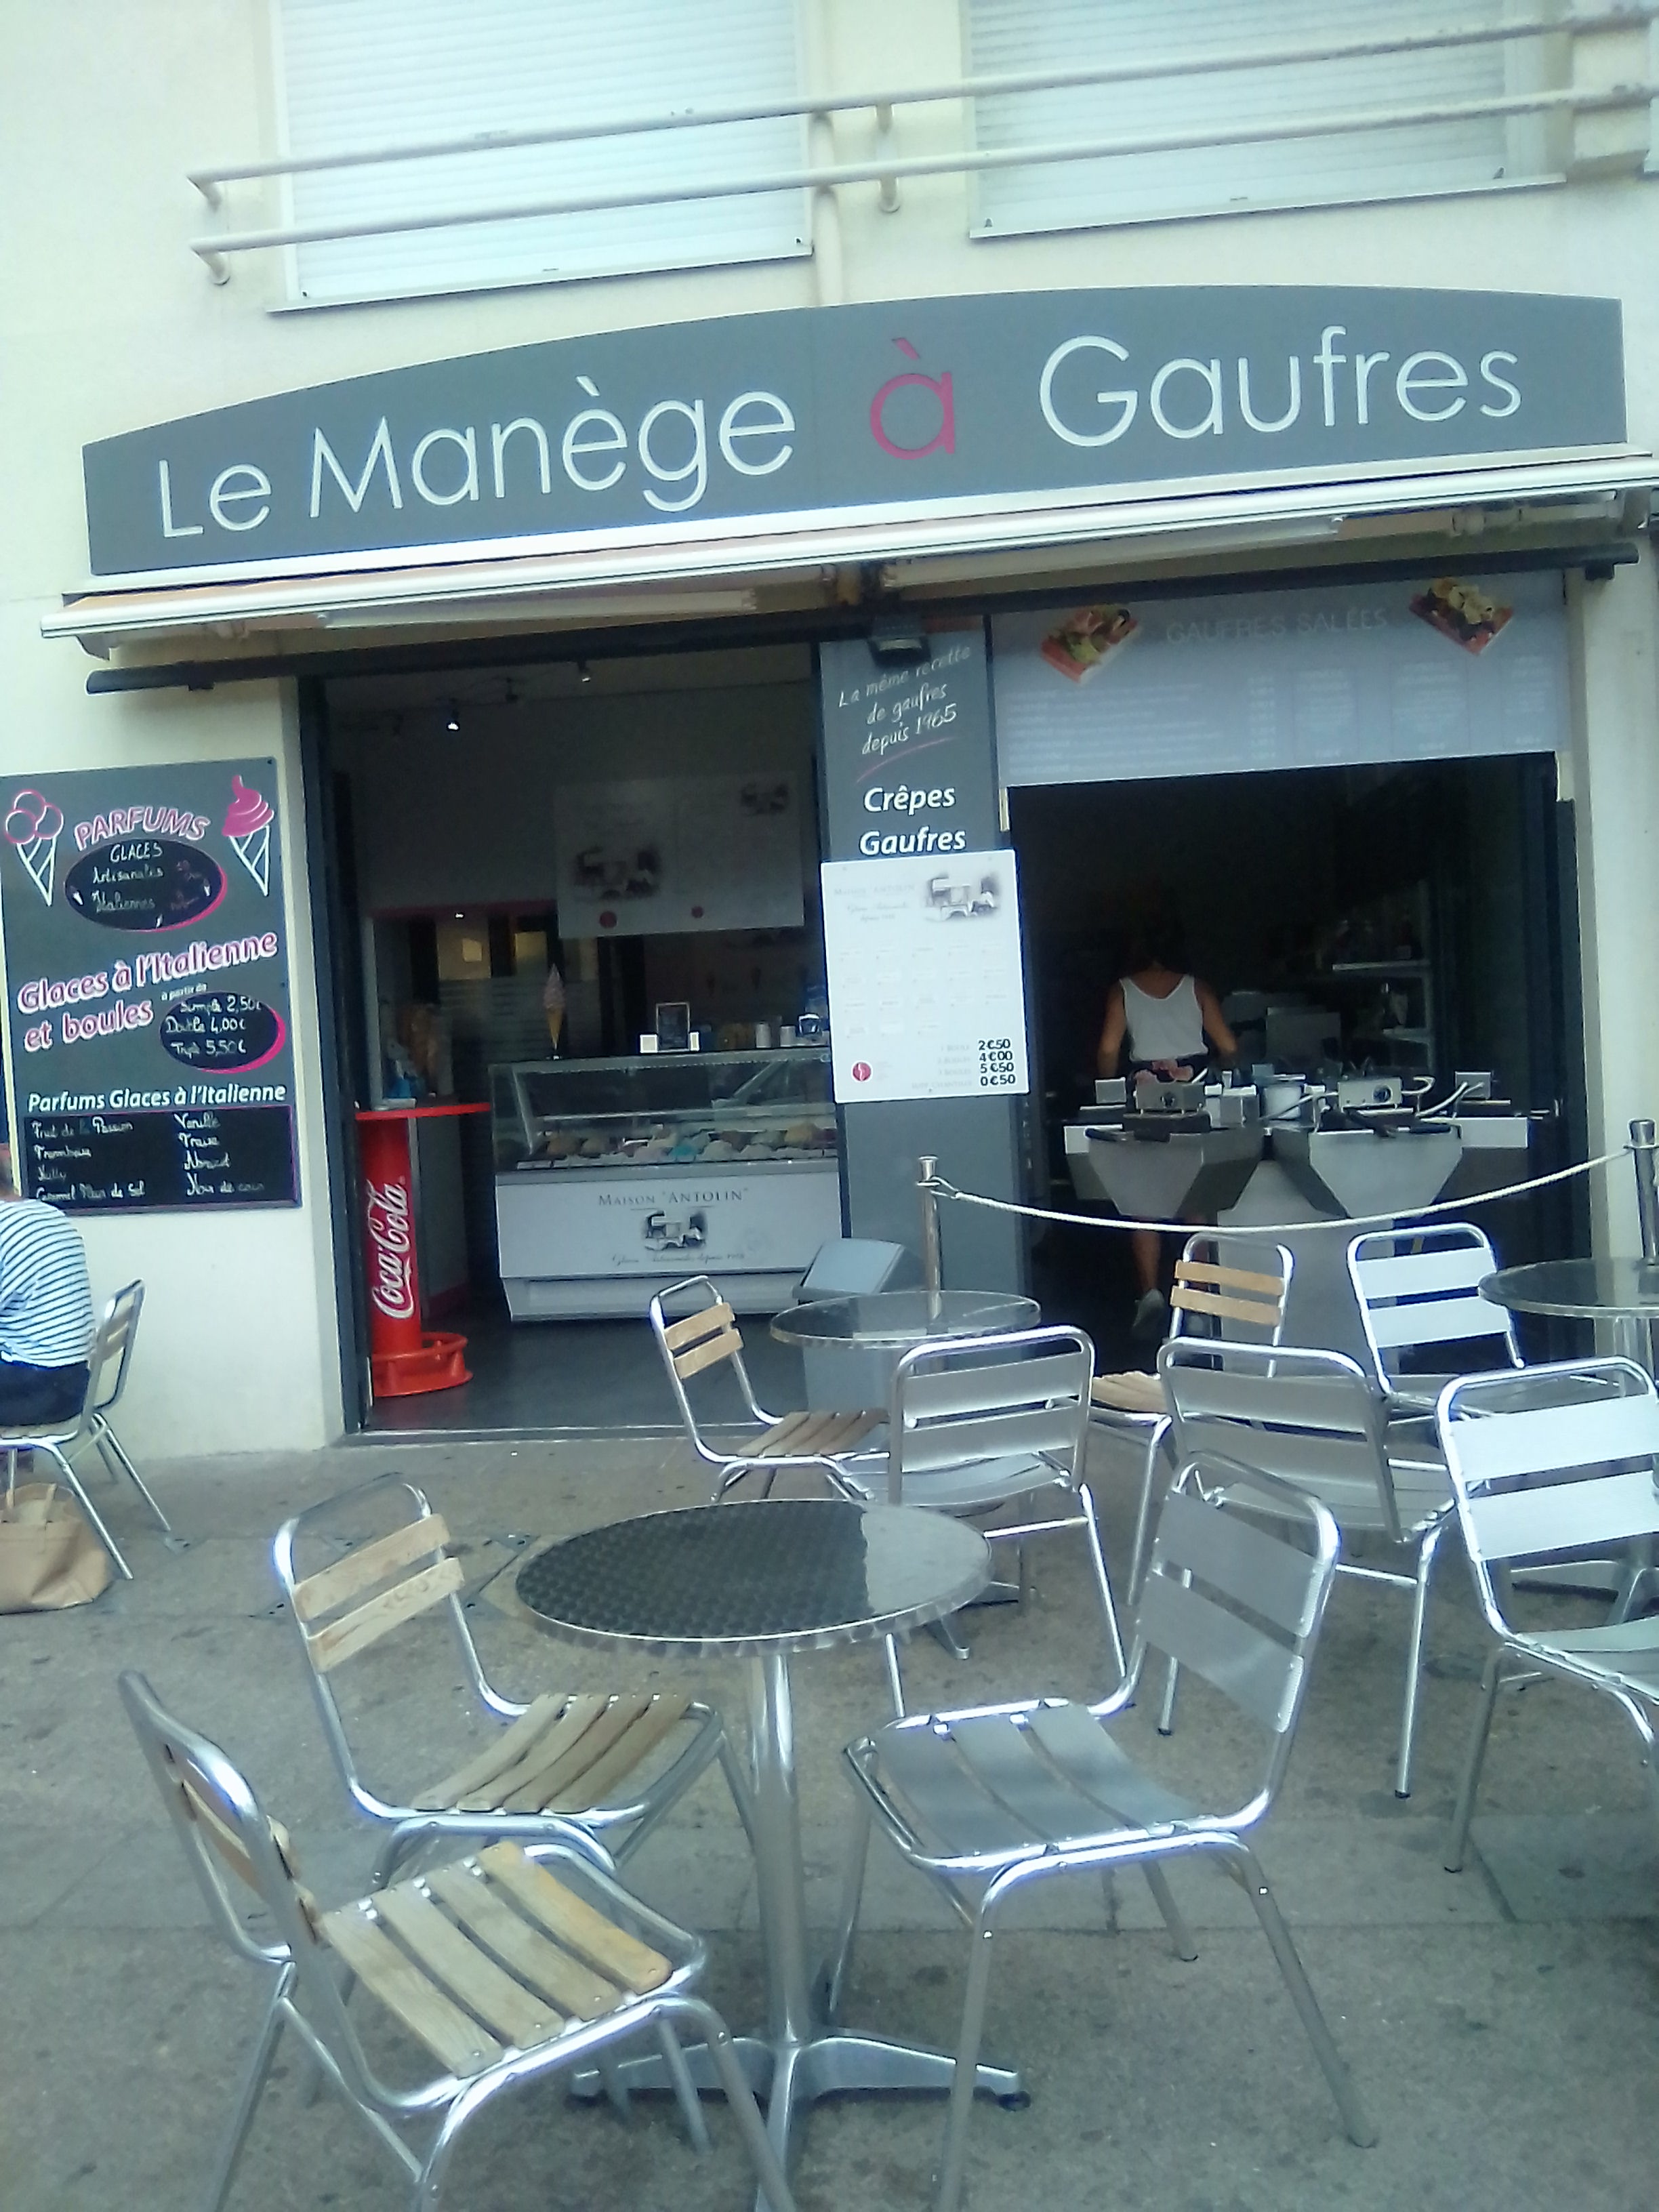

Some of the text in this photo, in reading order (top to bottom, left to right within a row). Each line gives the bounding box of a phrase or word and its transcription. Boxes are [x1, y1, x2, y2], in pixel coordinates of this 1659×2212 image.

[157, 325, 1522, 539] Le Manège à Gaufres
[839, 689, 860, 708] La
[916, 645, 970, 678] recette
[867, 682, 947, 725] de gaufres
[861, 703, 958, 755] depuis 1965
[864, 785, 956, 816] Crêpes
[74, 806, 211, 851] PARFUMS
[859, 826, 967, 856] Gaufres
[110, 842, 163, 863] GLACES
[18, 932, 279, 1015] Glaces à l'Italienne
[24, 1000, 154, 1052] et boules
[28, 1083, 287, 1113] Parfums Glaces à l'Italienne
